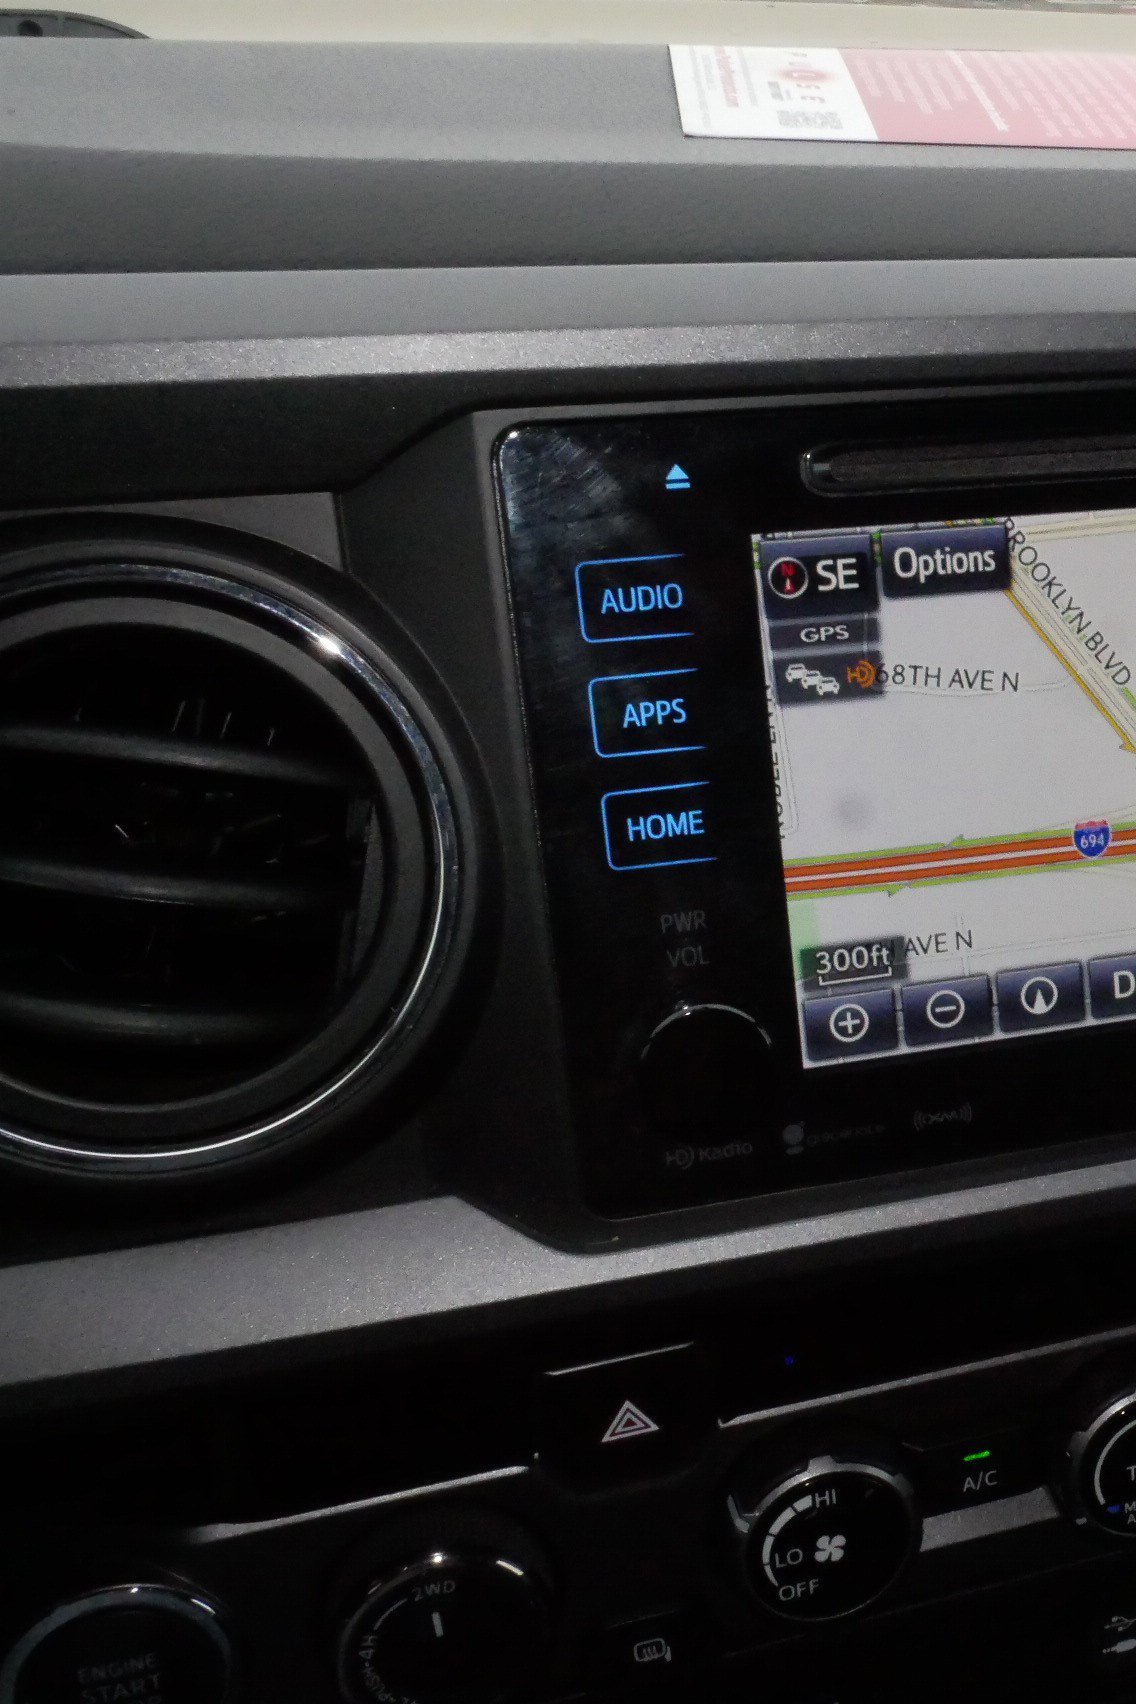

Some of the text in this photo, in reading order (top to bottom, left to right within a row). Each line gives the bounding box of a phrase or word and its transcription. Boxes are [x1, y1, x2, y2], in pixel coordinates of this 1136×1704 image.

[816, 558, 860, 592] SE
[893, 545, 996, 582] Options
[601, 584, 684, 613] AUDIO
[799, 623, 850, 644] GPS
[1084, 630, 1131, 686] BLVD
[877, 664, 1020, 693] 68TH AVE N
[622, 698, 687, 729] APPS
[626, 810, 706, 841] HOME
[1080, 832, 1105, 849] 694
[660, 910, 708, 934] PWR
[666, 945, 711, 968] VOL
[904, 932, 948, 957] AVE
[955, 929, 974, 950] N
[815, 945, 892, 976] 300ft
[962, 1470, 999, 1494] A/C
[814, 1489, 838, 1509] HI
[774, 1548, 804, 1569] LO
[411, 1580, 457, 1602] 2WD
[778, 1578, 820, 1602] OFF
[358, 1634, 379, 1660] 4H
[76, 1651, 158, 1685] ENGINE
[80, 1672, 162, 1704] START
